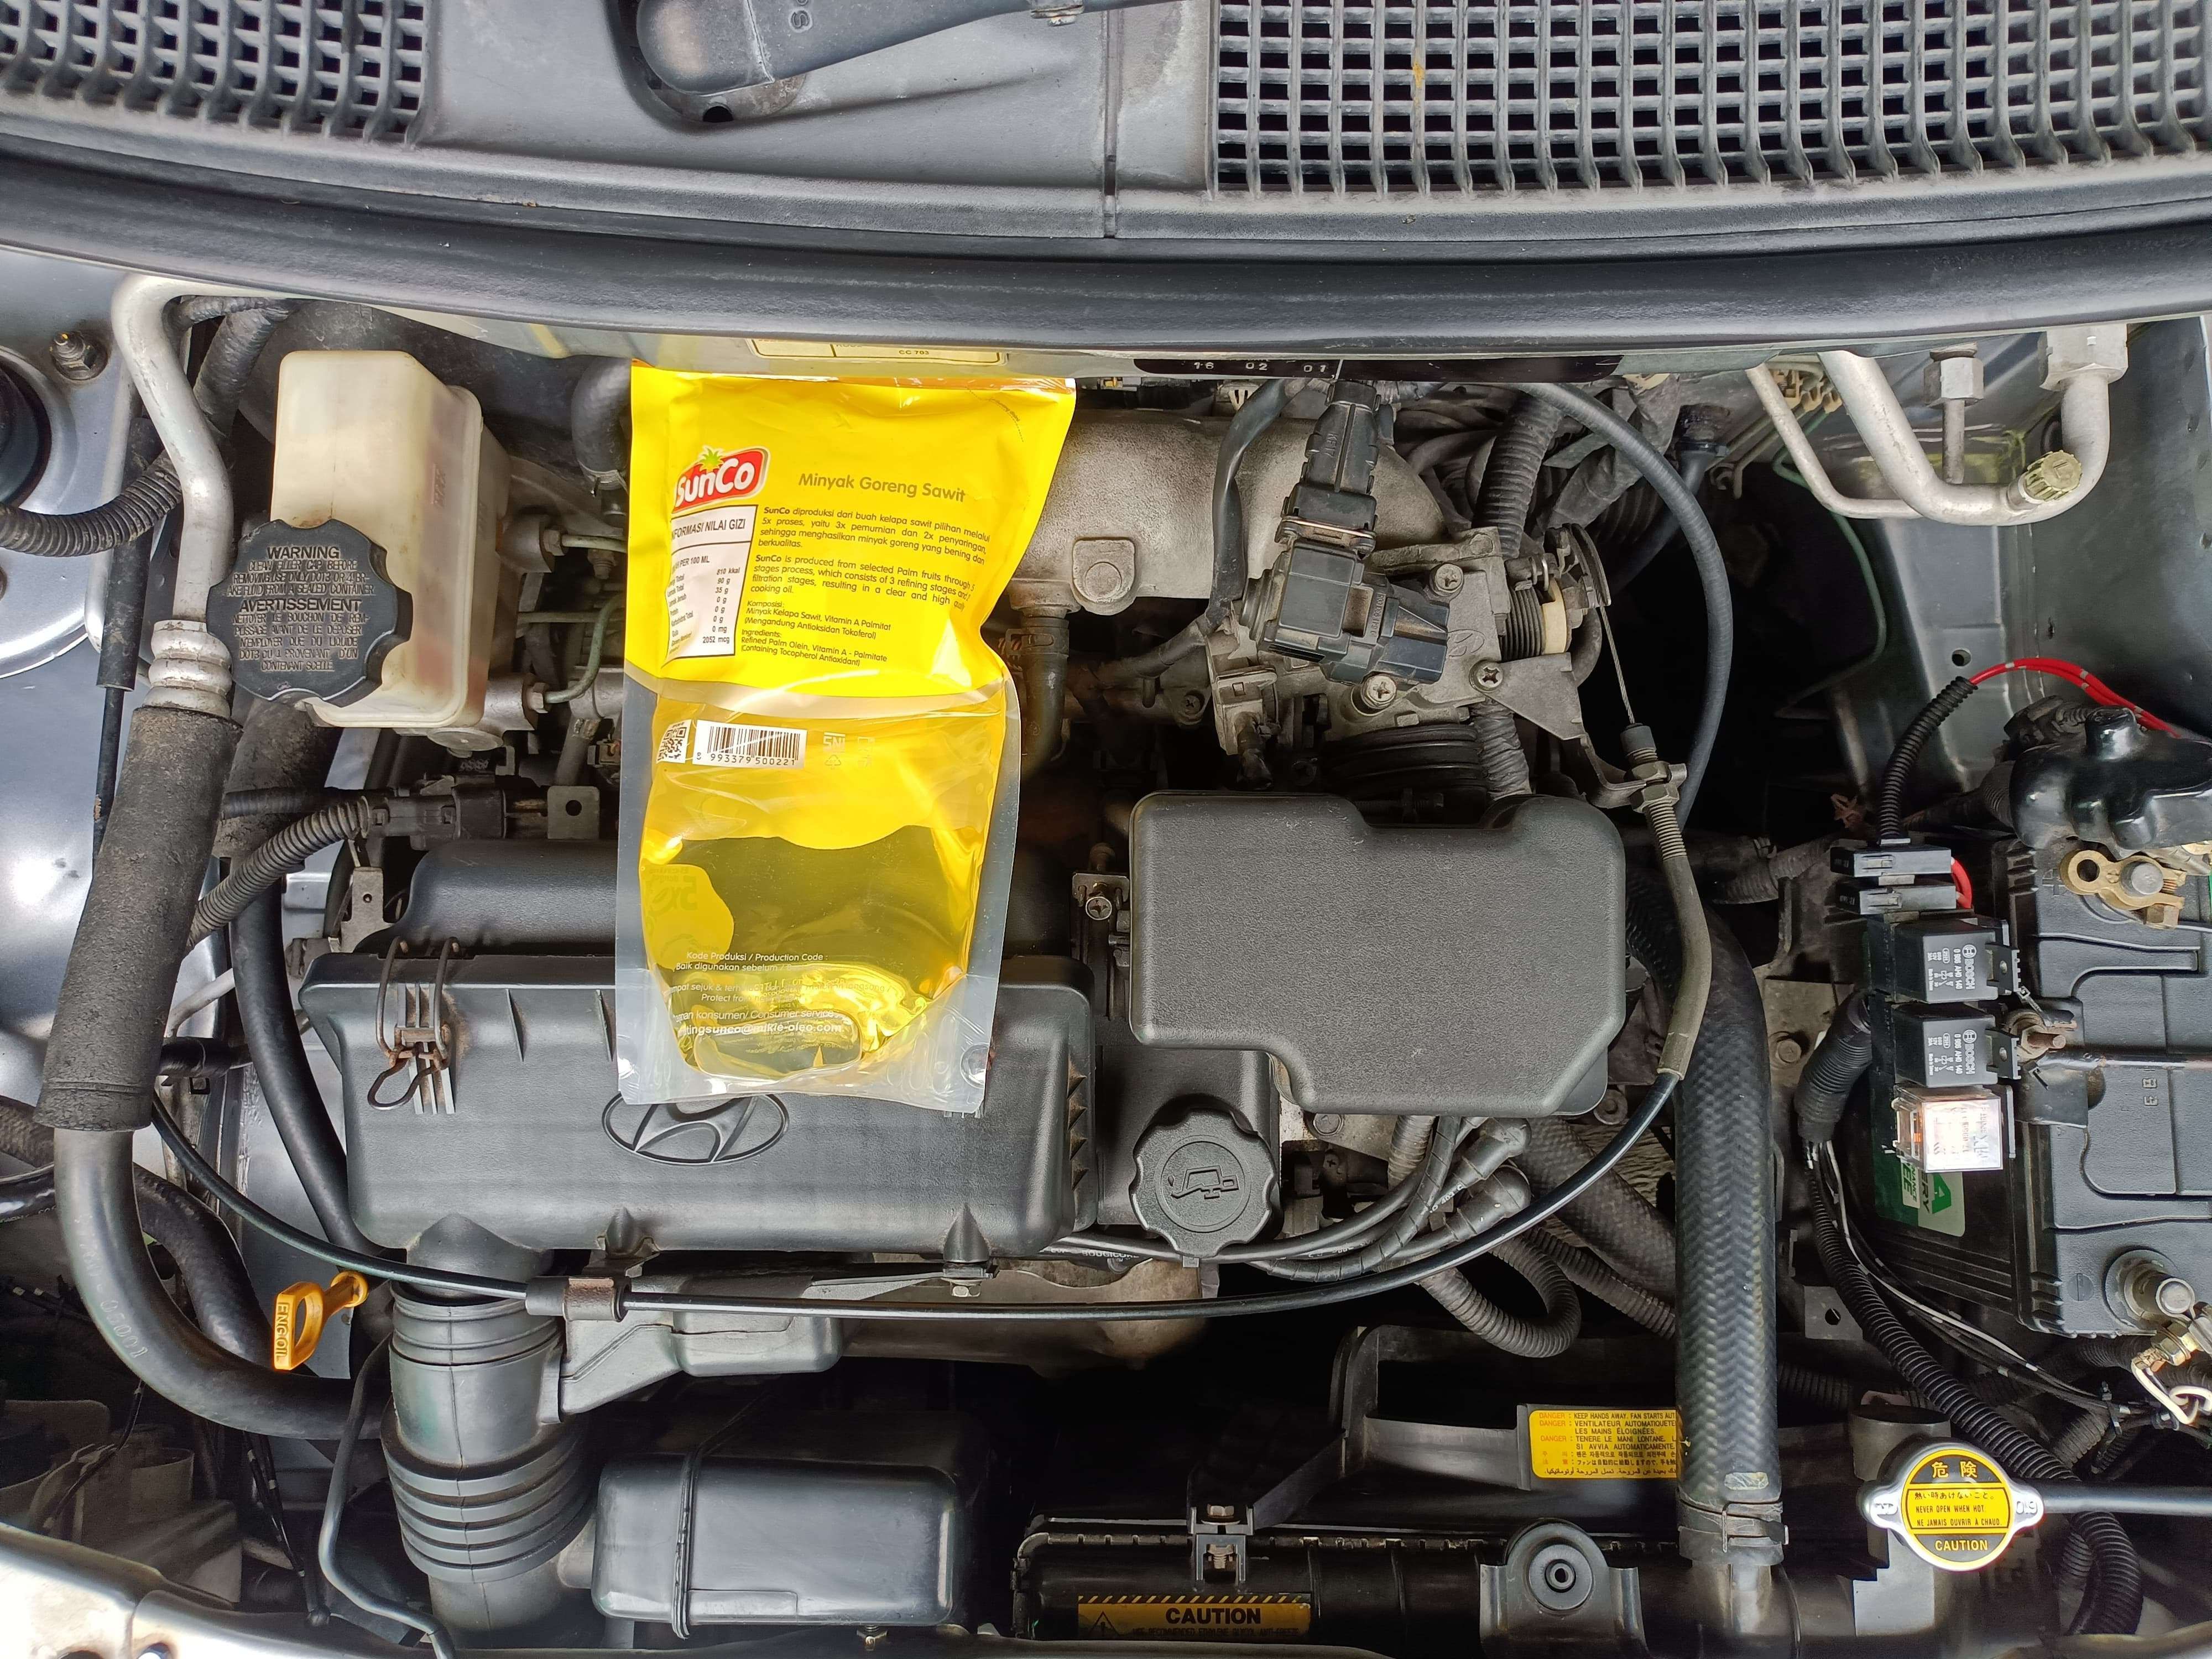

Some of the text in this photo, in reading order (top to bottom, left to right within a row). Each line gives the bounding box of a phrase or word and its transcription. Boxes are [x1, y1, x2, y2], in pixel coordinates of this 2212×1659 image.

[676, 458, 755, 507] SunCo
[799, 473, 966, 502] Minyak Goreng Sawit
[705, 519, 746, 531] NILAI GIZI
[792, 508, 834, 517] diproduksi
[837, 510, 853, 518] dari
[855, 512, 877, 520] buah
[880, 514, 907, 524] kelapa
[910, 519, 932, 528] sawit
[935, 522, 961, 533] pilihan
[964, 529, 991, 542] melalui
[811, 520, 830, 528] yaitu
[851, 524, 896, 535] pemurnian
[901, 528, 918, 537] dan
[924, 531, 934, 540] 2x
[267, 546, 340, 559] WARNING
[760, 528, 985, 566] sehingga menghasilkan minyak goreng yang bening dan
[306, 560, 358, 571] CAP BEFORE
[691, 556, 700, 565] 100
[701, 555, 710, 564] ML
[333, 573, 345, 582] OR
[754, 565, 779, 573] stages
[818, 569, 842, 578] which
[844, 572, 877, 582] consists
[897, 578, 928, 591] refining
[930, 584, 956, 595] stages
[794, 556, 834, 566] produced
[838, 559, 856, 568] from
[860, 563, 894, 574] selected
[897, 567, 918, 577] Palm
[922, 570, 941, 581] fruits
[945, 575, 971, 590] through
[298, 583, 375, 595] SEALED CONTAINER
[750, 585, 780, 594] cooking
[822, 580, 857, 592] resulting
[886, 587, 906, 597] clear
[932, 594, 950, 605] high
[239, 598, 362, 612] AVERTISSEMENT
[288, 613, 342, 623] BOUCHON DE
[773, 608, 799, 618] Kelapa
[825, 614, 852, 624] Vitamin
[861, 619, 891, 630] Palmitat
[744, 617, 876, 640] (Mengandung Antioksidan Tokoferol)
[239, 649, 260, 660] DOT3
[769, 638, 787, 646] Palm
[812, 644, 839, 655] Vitamin
[854, 650, 888, 662] Palmitate
[780, 648, 817, 659] Tocopherol
[819, 654, 860, 666] Antioxidant)
[709, 754, 751, 764] 993379
[755, 757, 795, 766] 500221
[711, 952, 747, 961] Produksi
[695, 963, 740, 973] digunakan
[1964, 958, 1975, 990] BOSCH
[750, 1010, 798, 1019] Consumer
[1965, 1044, 1975, 1074] BOSCH
[1935, 1540, 1988, 1551] CAUTION
[1165, 1608, 1261, 1625] CAUTION
